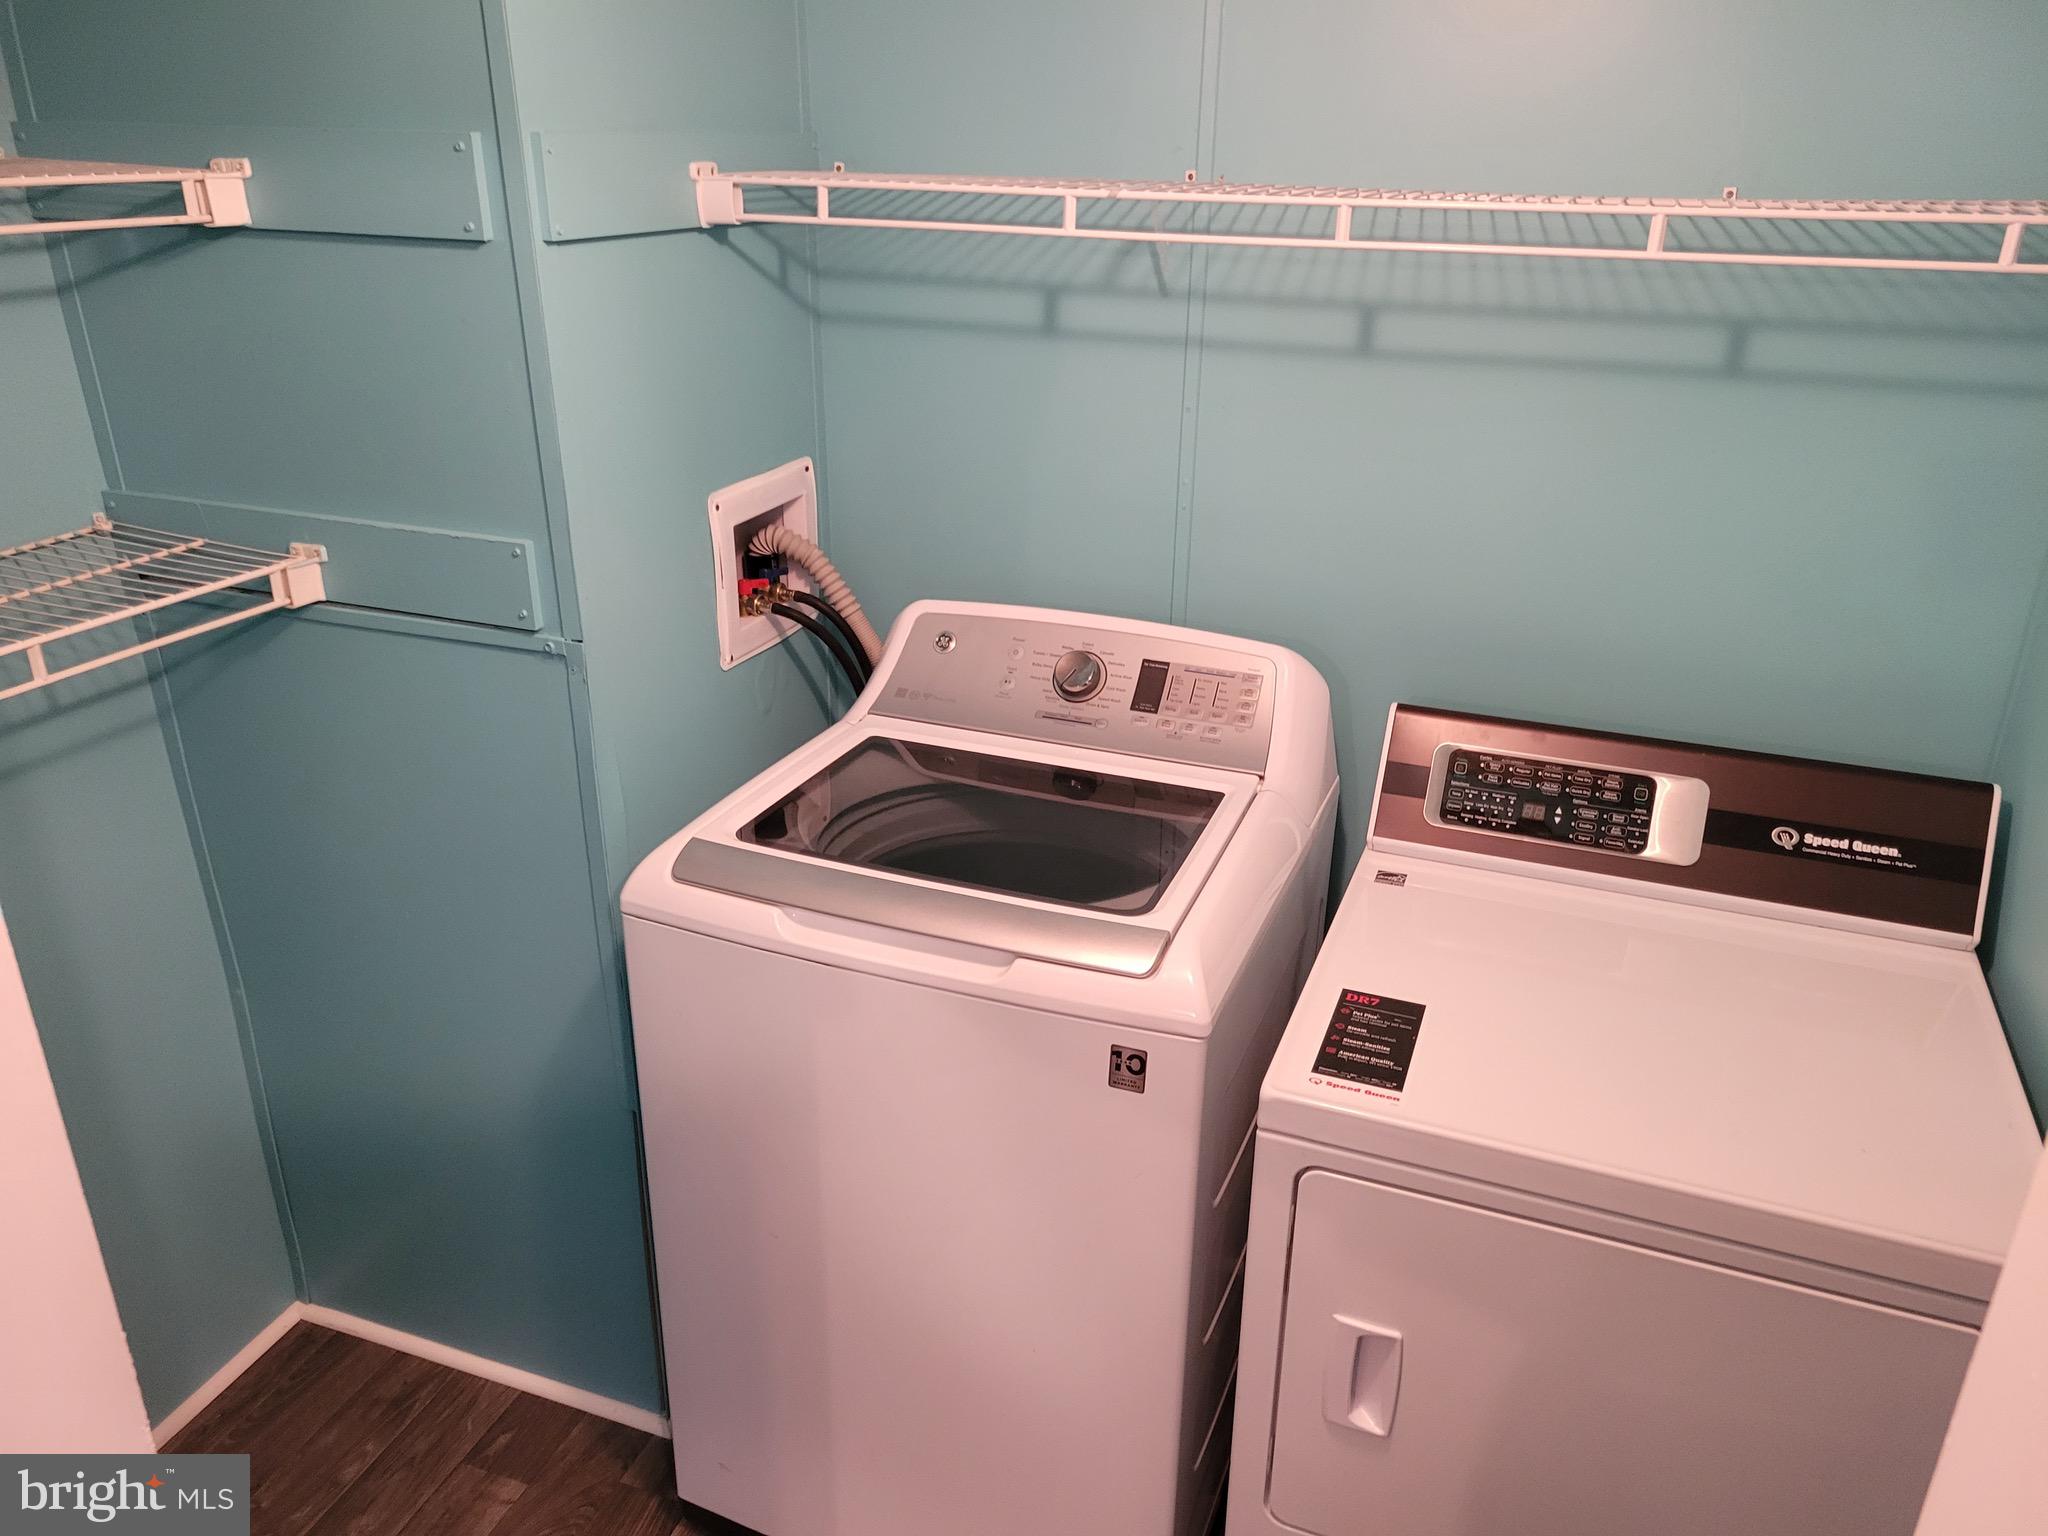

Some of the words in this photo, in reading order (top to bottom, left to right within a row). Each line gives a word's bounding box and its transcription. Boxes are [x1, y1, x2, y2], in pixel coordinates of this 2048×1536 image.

[1803, 833, 1850, 850] Speed
[1345, 992, 1380, 1006] DR7
[1347, 1025, 1367, 1033] Steam
[1111, 1050, 1146, 1076] 10
[1338, 1050, 1370, 1061] American
[1370, 1057, 1395, 1068] Quality
[1325, 1081, 1361, 1093] Speed
[1364, 1090, 1400, 1102] Queen
